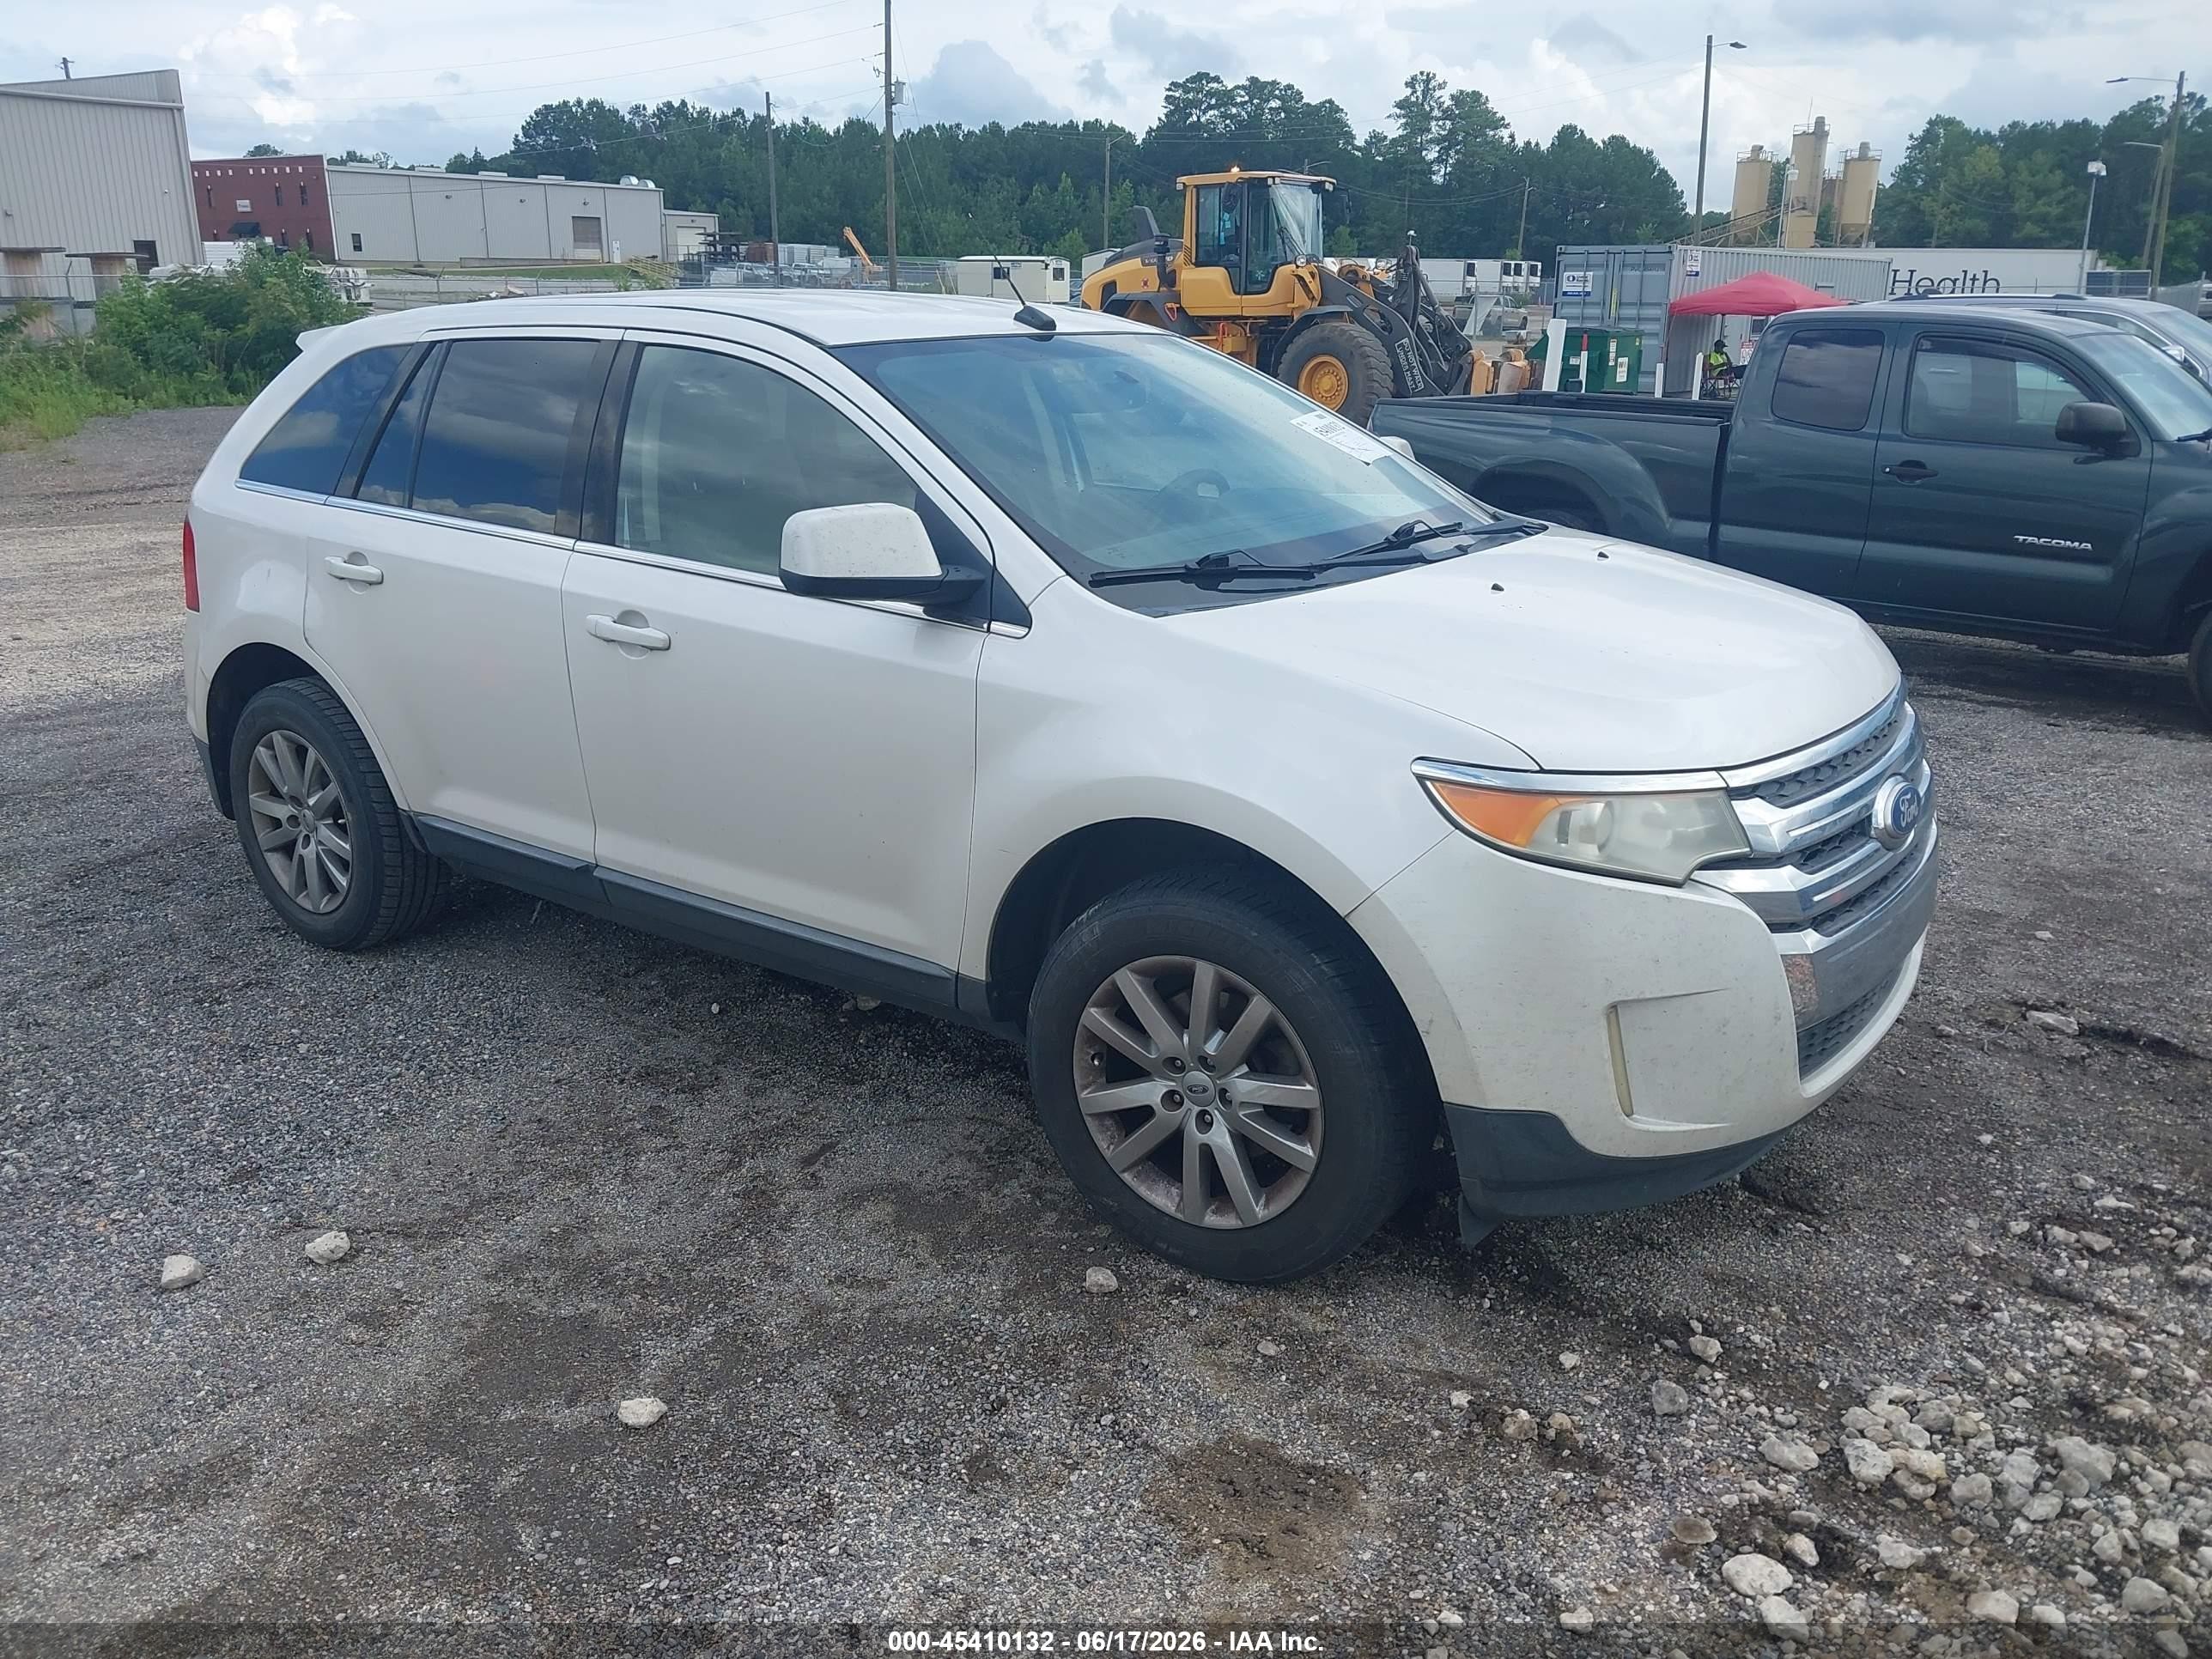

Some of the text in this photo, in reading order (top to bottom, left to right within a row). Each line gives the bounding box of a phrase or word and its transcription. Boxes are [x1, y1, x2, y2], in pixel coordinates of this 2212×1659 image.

[1889, 269, 2001, 295] Health
[1397, 347, 1416, 389] UNDER MAST
[1407, 351, 1417, 367] NOT
[1413, 368, 1424, 389] WALK
[2013, 535, 2094, 550] TACOMA
[1899, 790, 1918, 828] Ford
